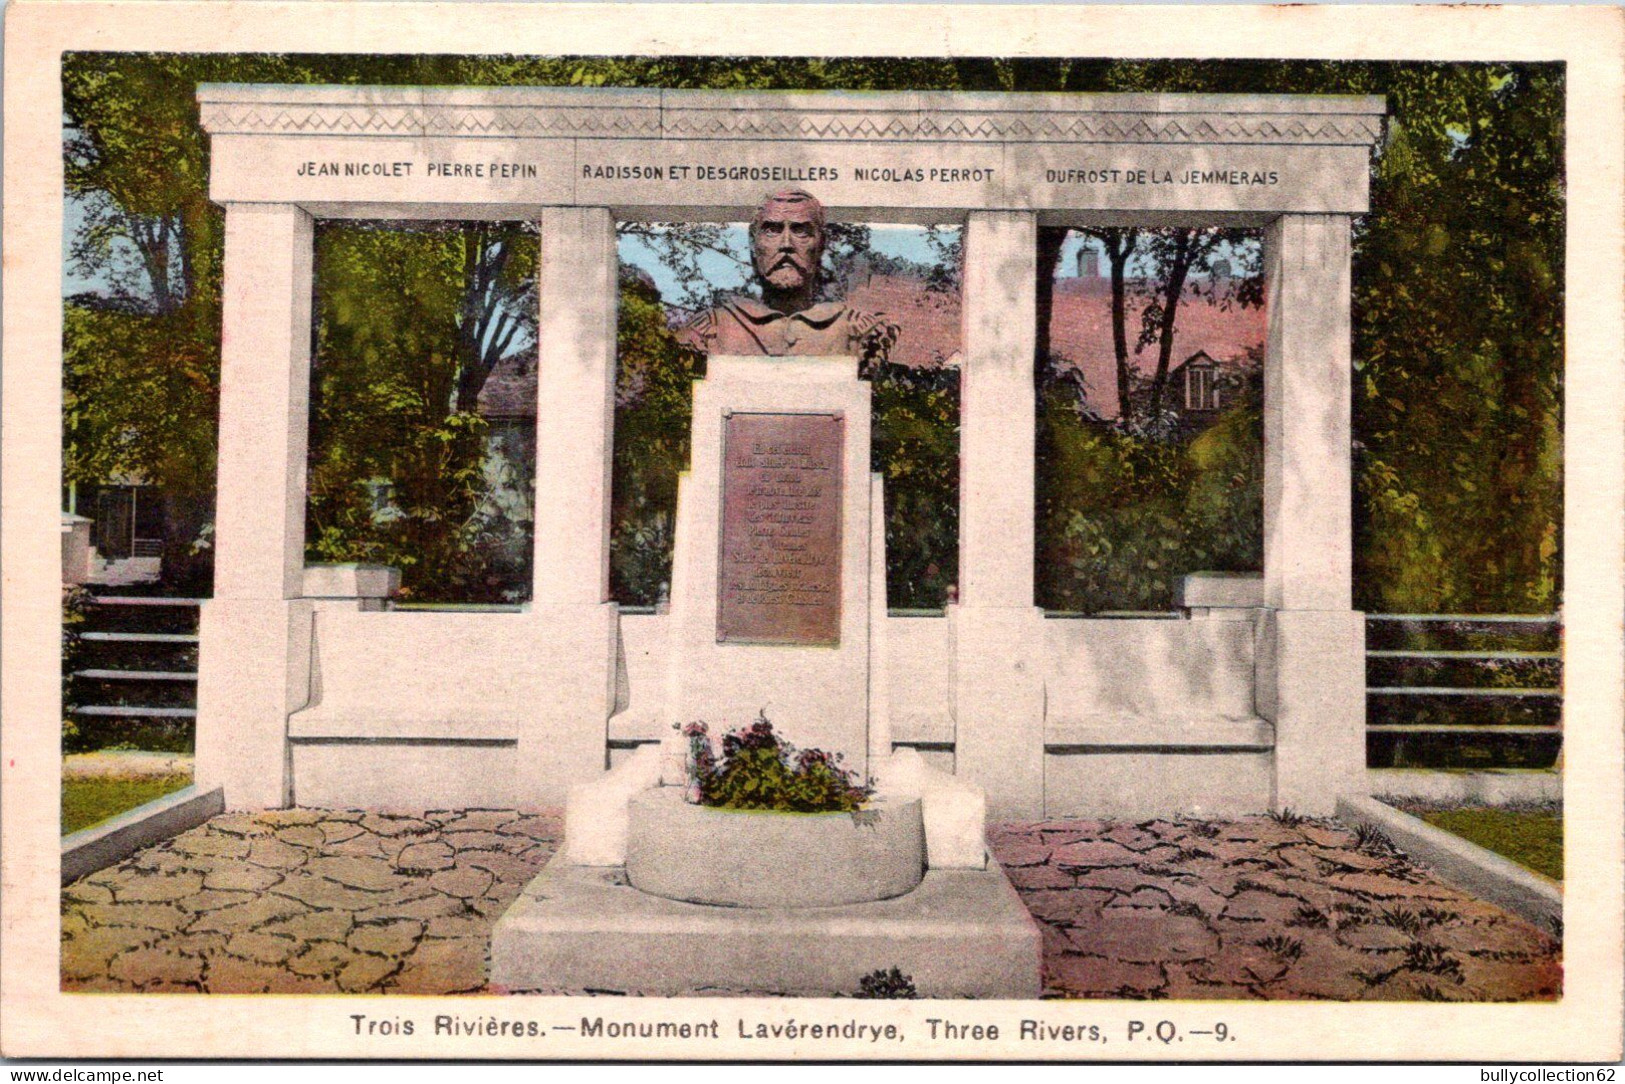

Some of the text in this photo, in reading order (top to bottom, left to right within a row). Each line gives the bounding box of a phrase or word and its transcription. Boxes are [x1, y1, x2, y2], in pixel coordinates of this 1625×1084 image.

[298, 162, 411, 177] JEAN NICOLET
[427, 163, 537, 178] PIERRE PEPIN
[583, 165, 838, 181] RADISSON ET DESGROSEILLERS
[855, 168, 994, 183] NICOLAS PERROT
[1046, 170, 1279, 185] DUFROST DE LA JEMMERAIS
[350, 1015, 414, 1035] Trois
[739, 1019, 905, 1043] Lavérendrye,
[926, 1019, 999, 1040] Three
[1021, 1019, 1107, 1044] Rivers,
